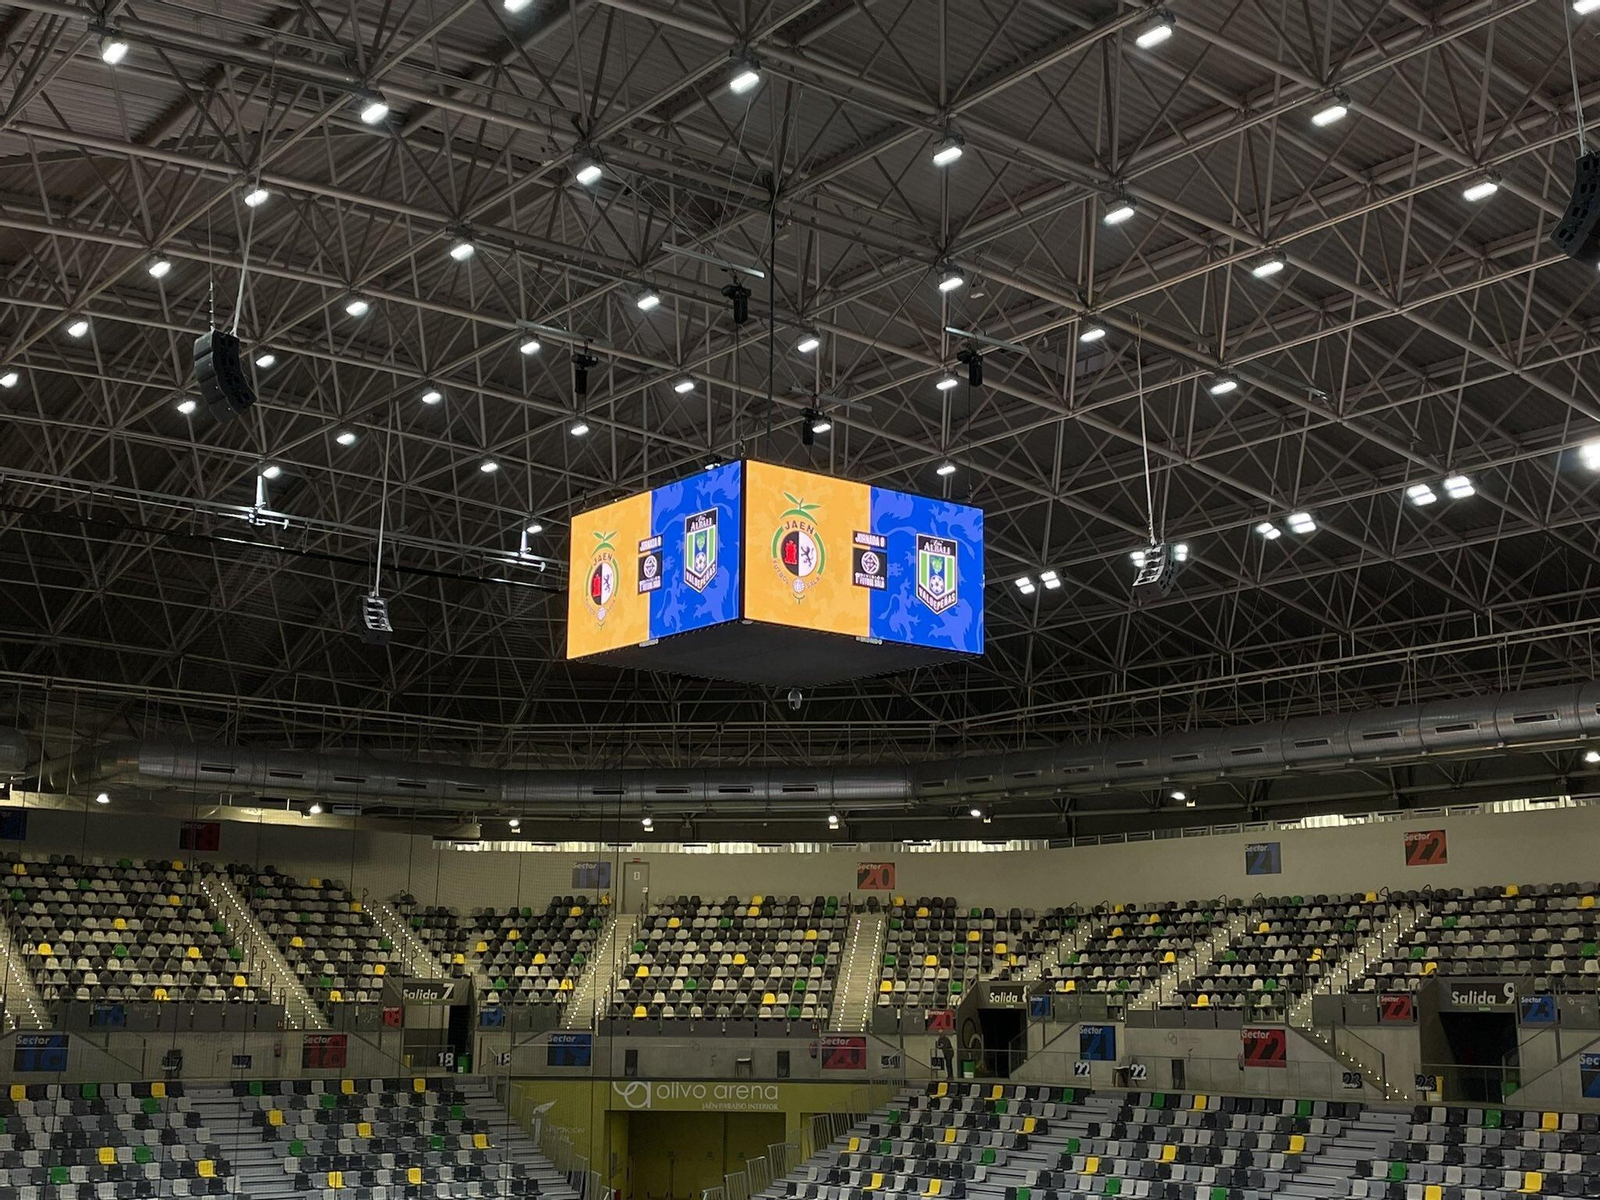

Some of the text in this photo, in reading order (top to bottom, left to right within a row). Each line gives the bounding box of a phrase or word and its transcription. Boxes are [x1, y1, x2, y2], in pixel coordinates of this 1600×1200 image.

[1404, 832, 1430, 841] Sector
[1245, 844, 1269, 852] Sector
[1405, 831, 1447, 865] 22
[858, 862, 882, 870] Sector
[1248, 845, 1280, 874] 21
[858, 864, 895, 889] 20
[403, 983, 455, 1000] Salida 7
[990, 992, 1018, 1003] Salida
[1451, 982, 1515, 1004] Salida 9
[1383, 996, 1411, 1020] 22
[1523, 997, 1554, 1022] 23
[928, 1010, 955, 1030] 20
[1080, 1026, 1102, 1035] Sector
[1242, 1029, 1271, 1039] Sector
[17, 1035, 50, 1045] Sector
[303, 1034, 332, 1044] Sector
[547, 1034, 577, 1043] Sector
[821, 1037, 851, 1046] Sector
[1082, 1027, 1115, 1060] 21
[822, 1037, 867, 1069] 20
[1245, 1030, 1287, 1067] 22
[438, 1052, 455, 1067] 18
[1075, 1062, 1090, 1076] 22
[1130, 1063, 1146, 1078] 22
[1343, 1072, 1362, 1088] 23
[657, 1082, 779, 1100] olivo arena
[747, 1103, 779, 1111] INTERIOR
